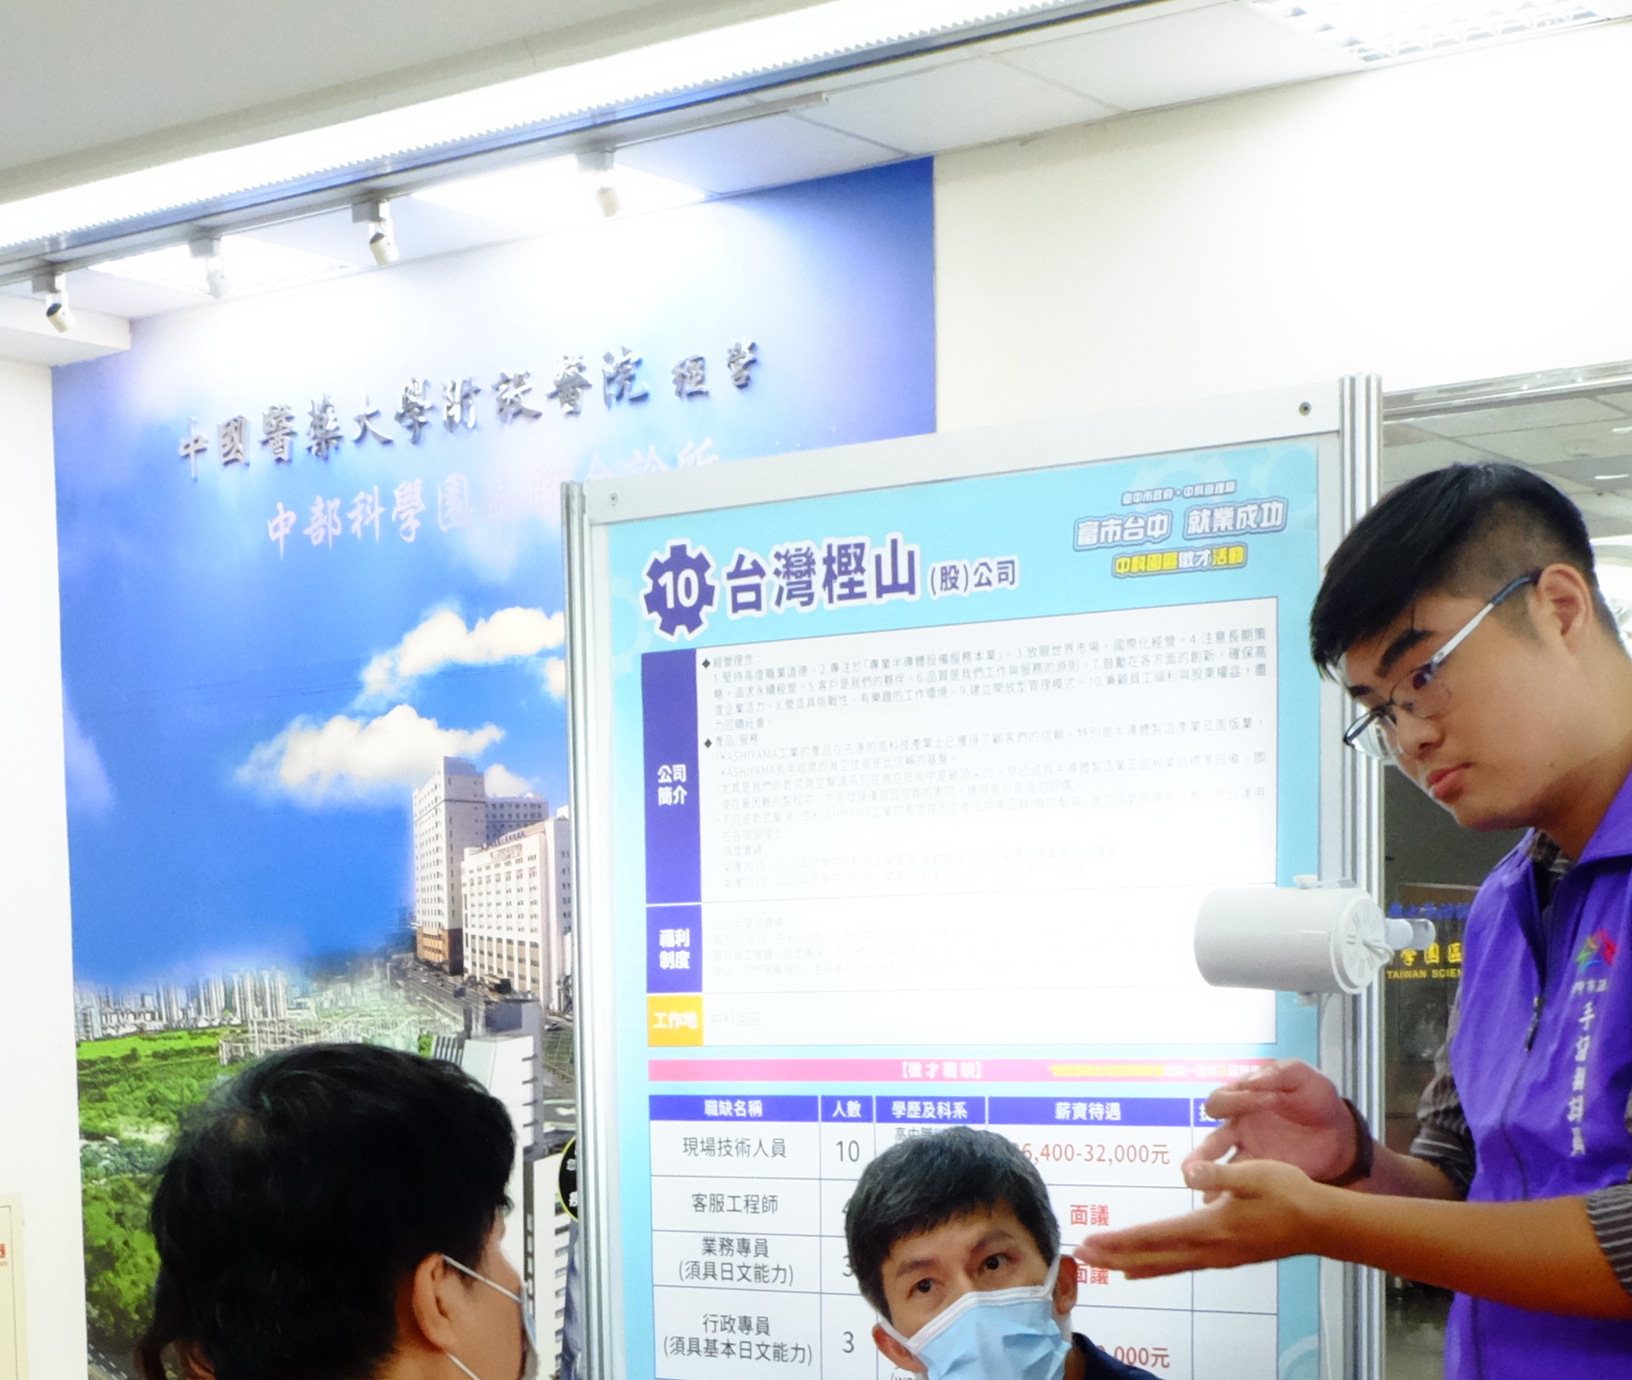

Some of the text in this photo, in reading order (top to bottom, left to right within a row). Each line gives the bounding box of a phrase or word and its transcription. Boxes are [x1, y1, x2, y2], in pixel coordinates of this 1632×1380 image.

[671, 336, 760, 400] 經營
[1077, 501, 1285, 545] 富市台中 就業成功
[660, 538, 1017, 614] 10 台灣樫山 (股)公司
[657, 764, 687, 784] 公司
[657, 786, 688, 806] 簡介
[659, 928, 690, 948] 福利
[659, 950, 690, 970] 制度
[1386, 969, 1427, 980] TAIWAN
[653, 1011, 699, 1030] 工作地
[704, 1099, 763, 1118] 職缺名稱
[832, 1100, 861, 1119] 人數
[892, 1101, 967, 1120] 學歷及科系
[1055, 1102, 1122, 1121] 薪資待遇
[682, 1136, 786, 1159] 現場技術人員
[835, 1140, 860, 1164] 10
[1018, 1143, 1171, 1166] 6,400-32,000元
[691, 1193, 779, 1215] 客服工程師
[1070, 1204, 1110, 1226] 面議
[701, 1235, 770, 1258] 業務專員
[679, 1260, 794, 1287] (須具日文能力)
[702, 1313, 771, 1337] 行政專員
[662, 1335, 813, 1367] (須具基本日文能力)
[842, 1330, 855, 1353] 3
